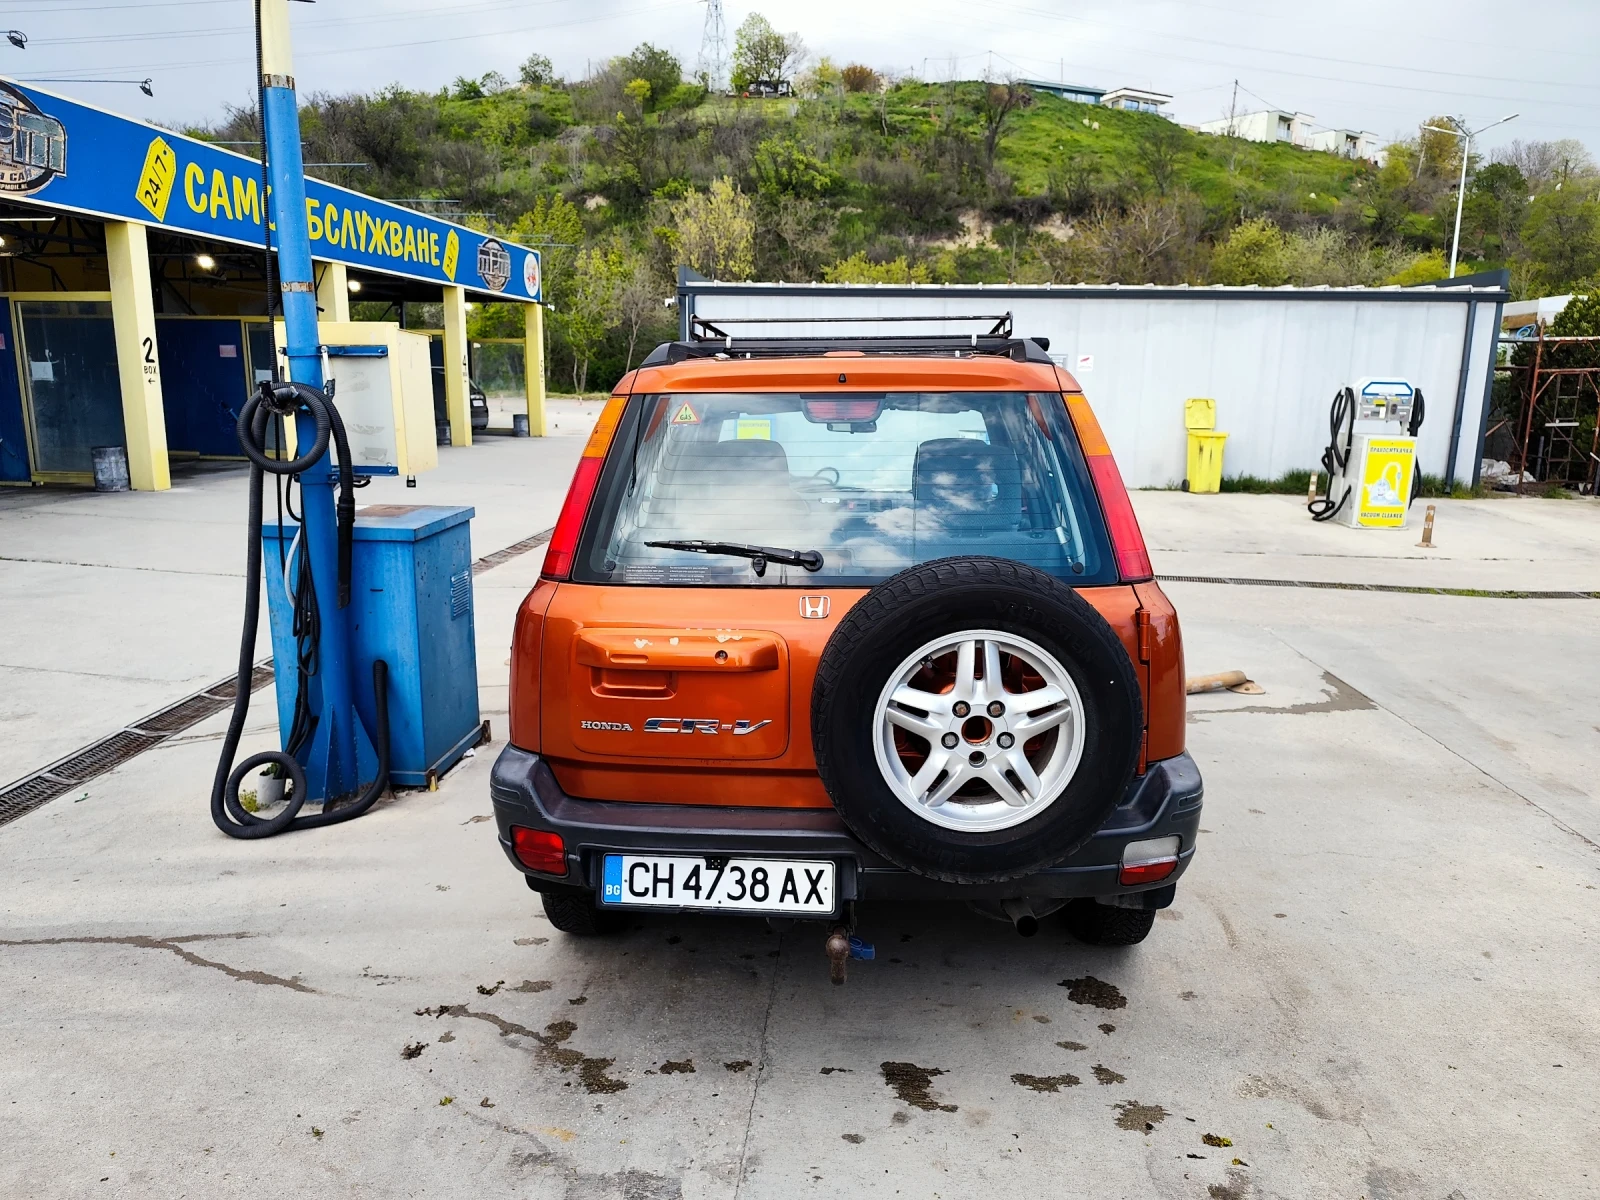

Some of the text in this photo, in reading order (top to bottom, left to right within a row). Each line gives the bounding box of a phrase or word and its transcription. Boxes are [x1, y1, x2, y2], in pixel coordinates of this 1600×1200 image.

[144, 153, 168, 209] 24/7
[184, 161, 441, 267] САМБСЛУЖВАНЕ
[142, 336, 156, 364] 2
[143, 365, 157, 375] BOX
[580, 717, 773, 735] HONDA CR-V
[605, 884, 621, 897] BG
[628, 861, 825, 906] CH 4738 AX
